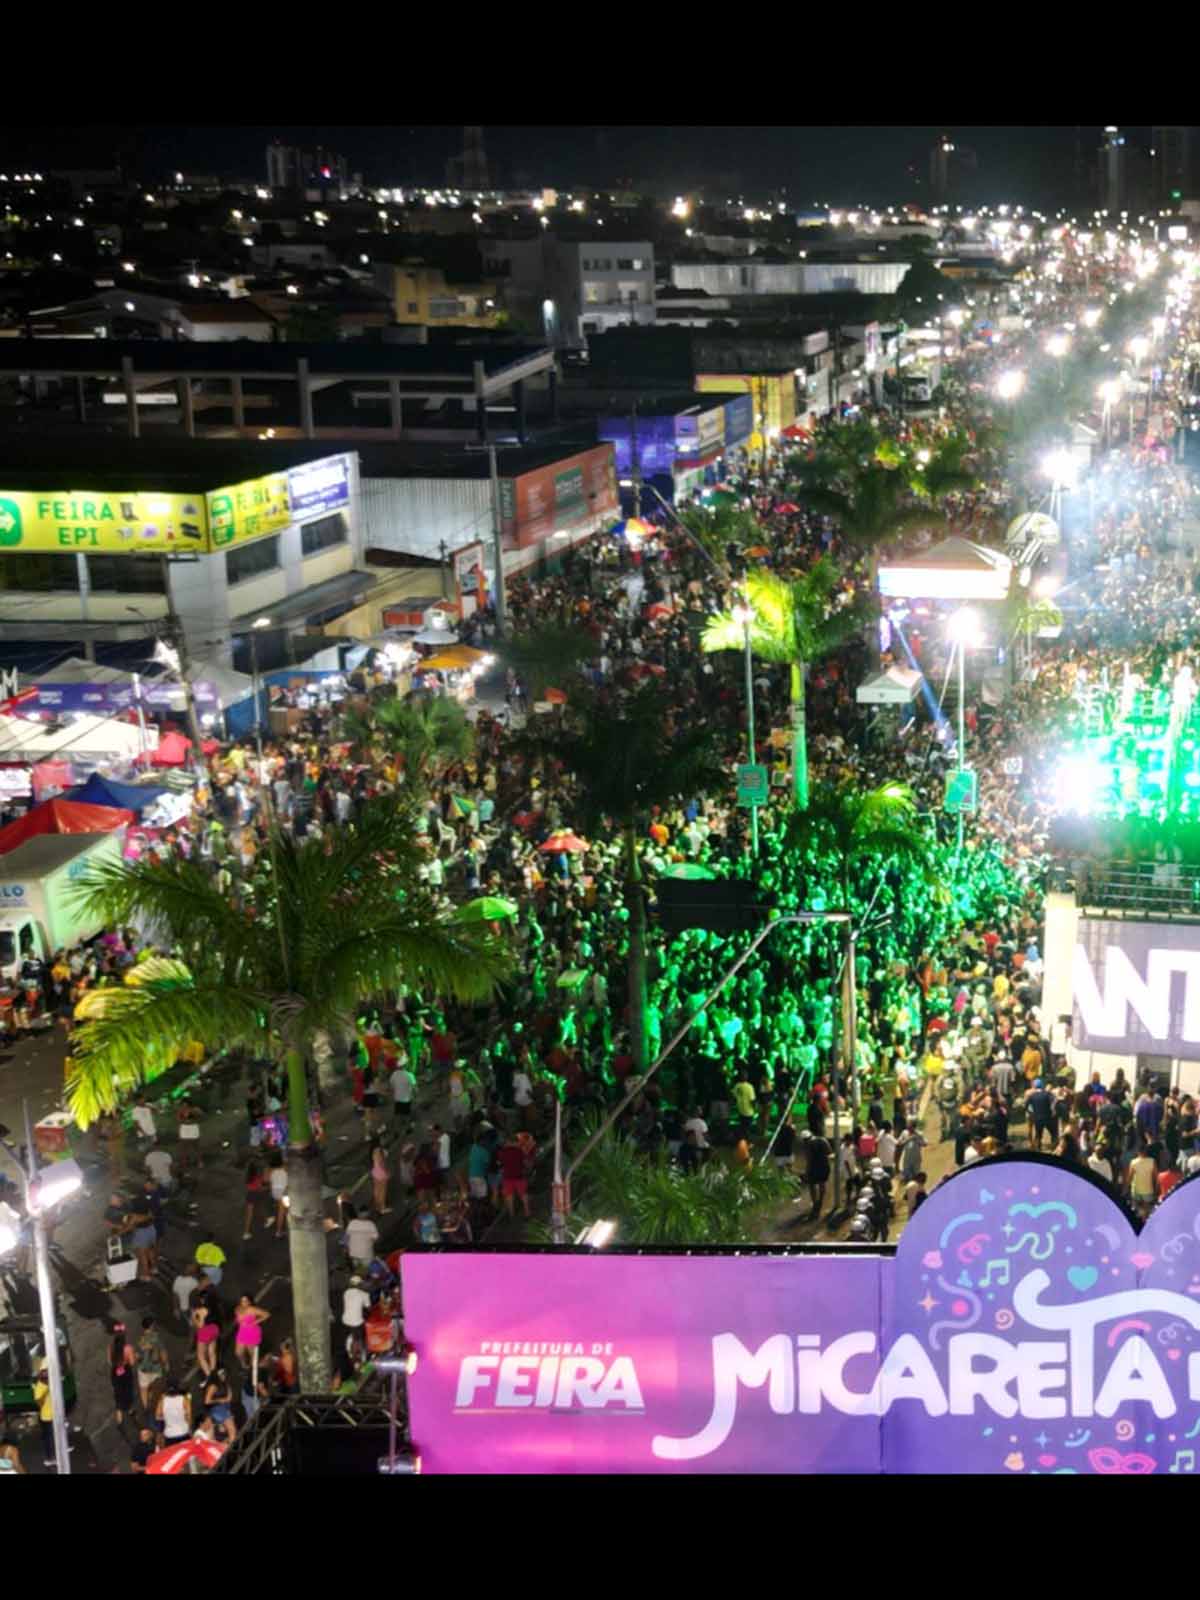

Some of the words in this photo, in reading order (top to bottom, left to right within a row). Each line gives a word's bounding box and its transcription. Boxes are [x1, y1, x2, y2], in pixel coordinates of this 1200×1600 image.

[37, 500, 114, 521] FEIRA
[58, 526, 100, 546] EPI
[0, 885, 24, 897] LO
[479, 1342, 585, 1355] PREFEITURA
[591, 1343, 614, 1355] DE
[454, 1355, 646, 1409] FEIRA
